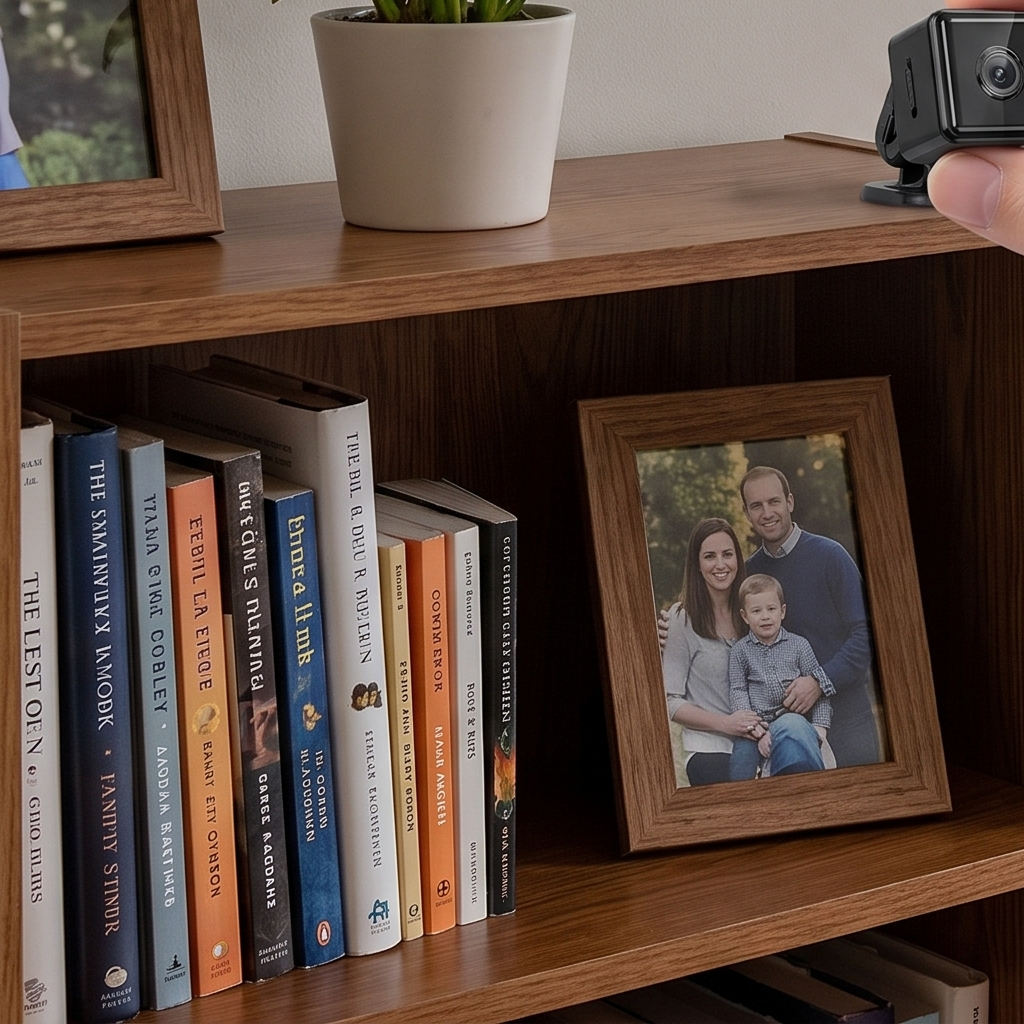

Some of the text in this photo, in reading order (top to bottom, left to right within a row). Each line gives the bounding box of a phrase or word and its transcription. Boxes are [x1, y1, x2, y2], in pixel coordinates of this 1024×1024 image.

[89, 460, 106, 502] THE
[23, 572, 40, 622] THE
[24, 628, 43, 691] LEST
